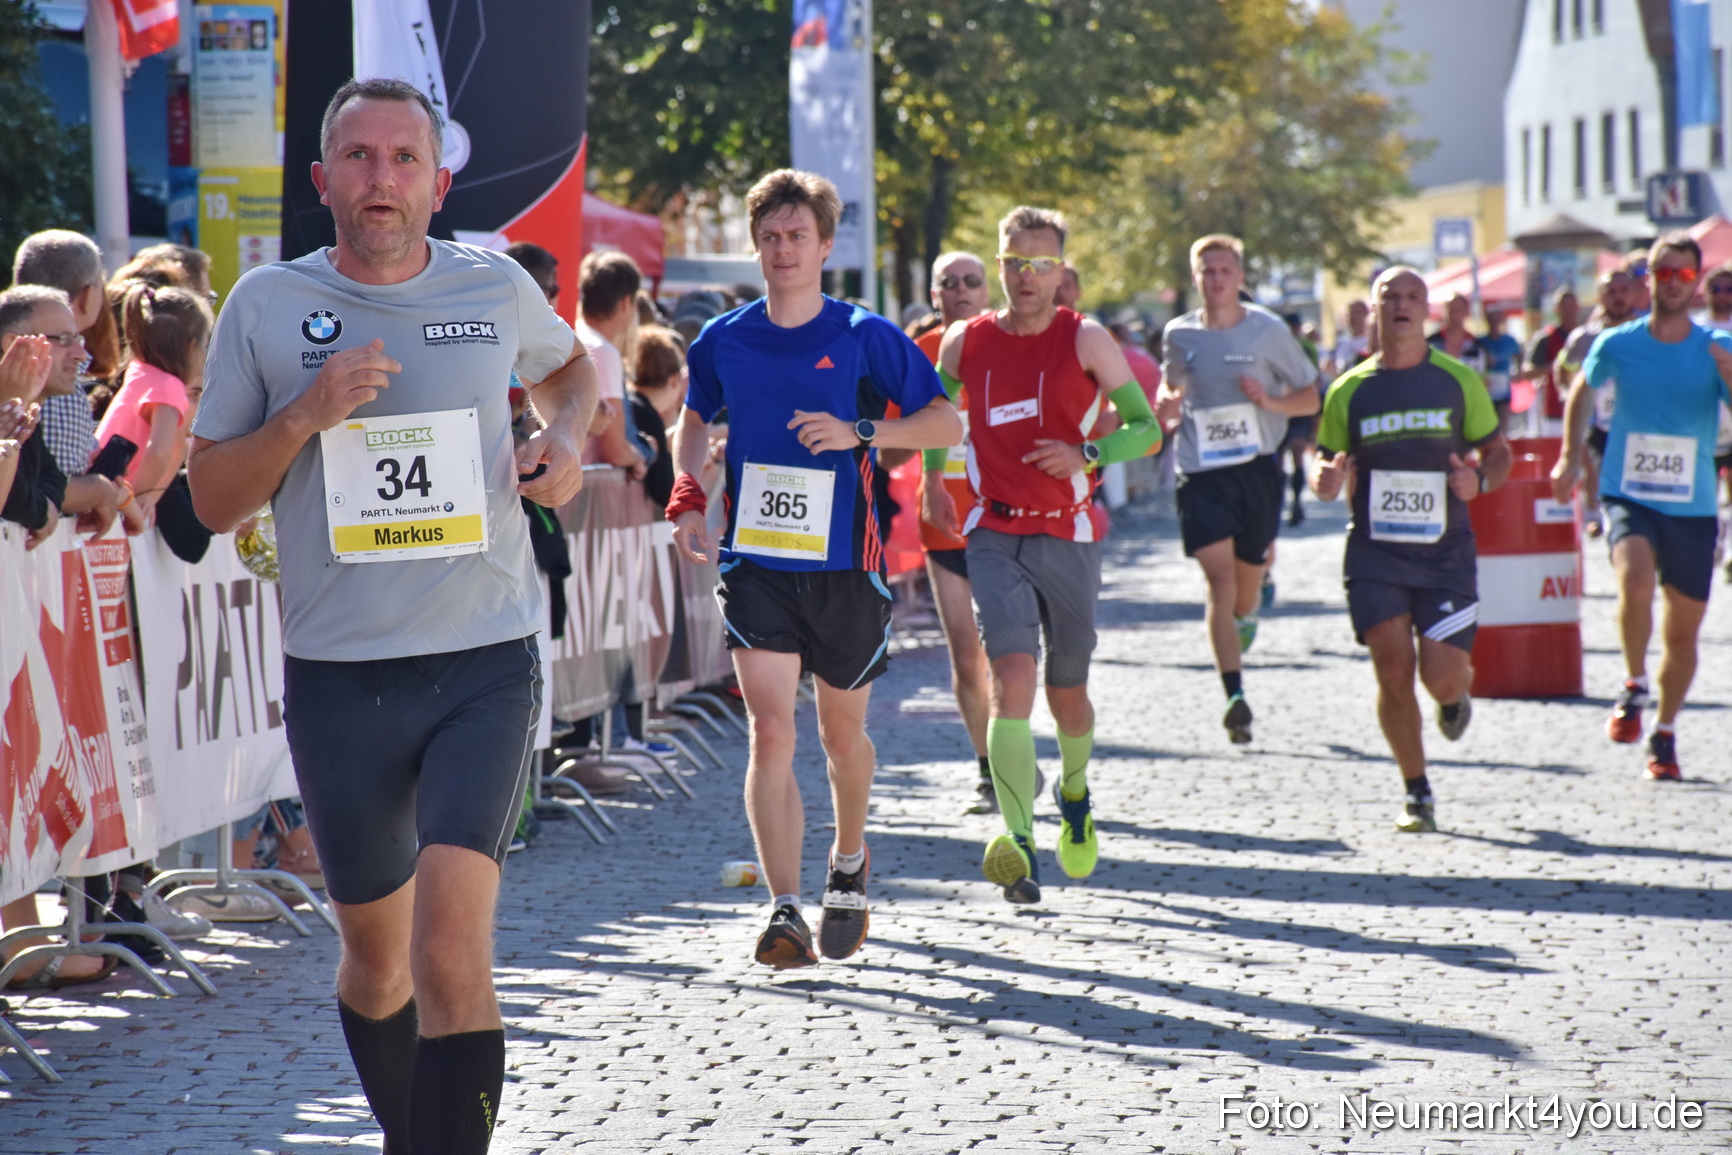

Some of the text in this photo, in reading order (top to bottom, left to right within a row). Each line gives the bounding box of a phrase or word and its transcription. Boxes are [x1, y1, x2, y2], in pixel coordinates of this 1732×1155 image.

[205, 192, 236, 220] 19.
[305, 310, 339, 323] BMW
[423, 321, 498, 340] BOCK
[425, 339, 451, 347] inspired
[1206, 420, 1248, 441] 2564
[1360, 407, 1453, 438] BOCK
[366, 427, 434, 447] BOCK
[1634, 452, 1684, 475] 2348
[375, 455, 432, 501] 34
[361, 505, 440, 518] PARTL Neumarkt
[760, 490, 808, 520] 365
[1381, 490, 1434, 513] 2530
[374, 526, 444, 546] Markus
